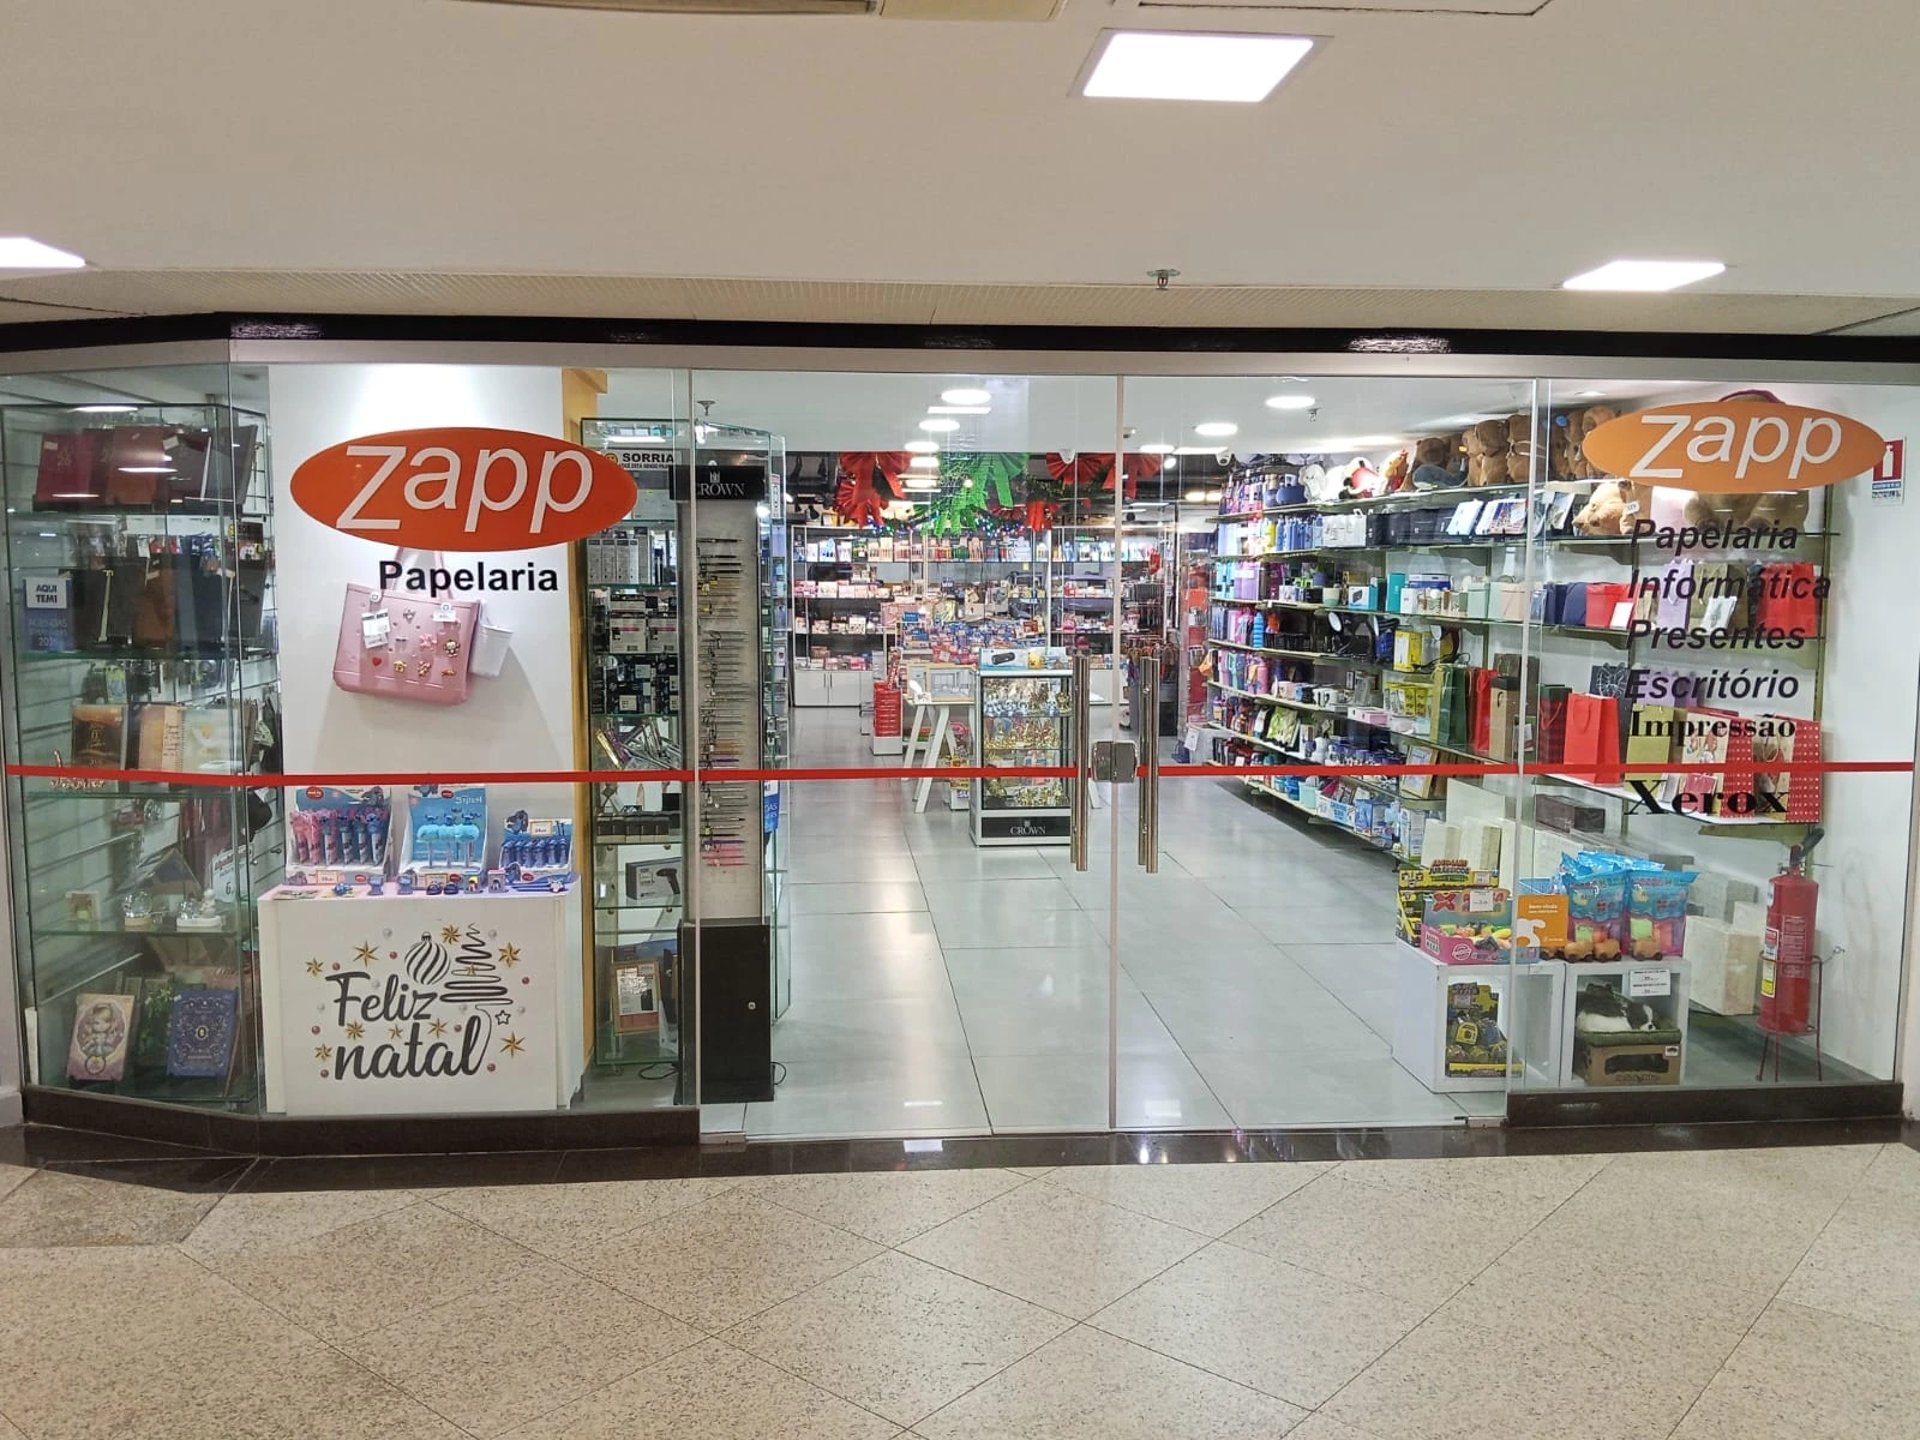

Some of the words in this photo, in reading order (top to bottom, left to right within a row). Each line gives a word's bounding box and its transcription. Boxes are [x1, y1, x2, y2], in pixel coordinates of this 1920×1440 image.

[622, 452, 674, 463] SORRIA
[1631, 519, 1798, 556] Papelaria
[36, 584, 58, 593] AQUI
[379, 560, 559, 598] Papelaria
[1627, 568, 1831, 600] Informática
[1627, 619, 1806, 650] Presentes
[1625, 668, 1800, 699] Escritório
[1629, 711, 1796, 747] Impressão
[1625, 779, 1790, 816] Xerox
[1009, 826, 1046, 836] CROWN
[325, 970, 438, 1027] Feliz
[334, 1014, 484, 1080] natal
